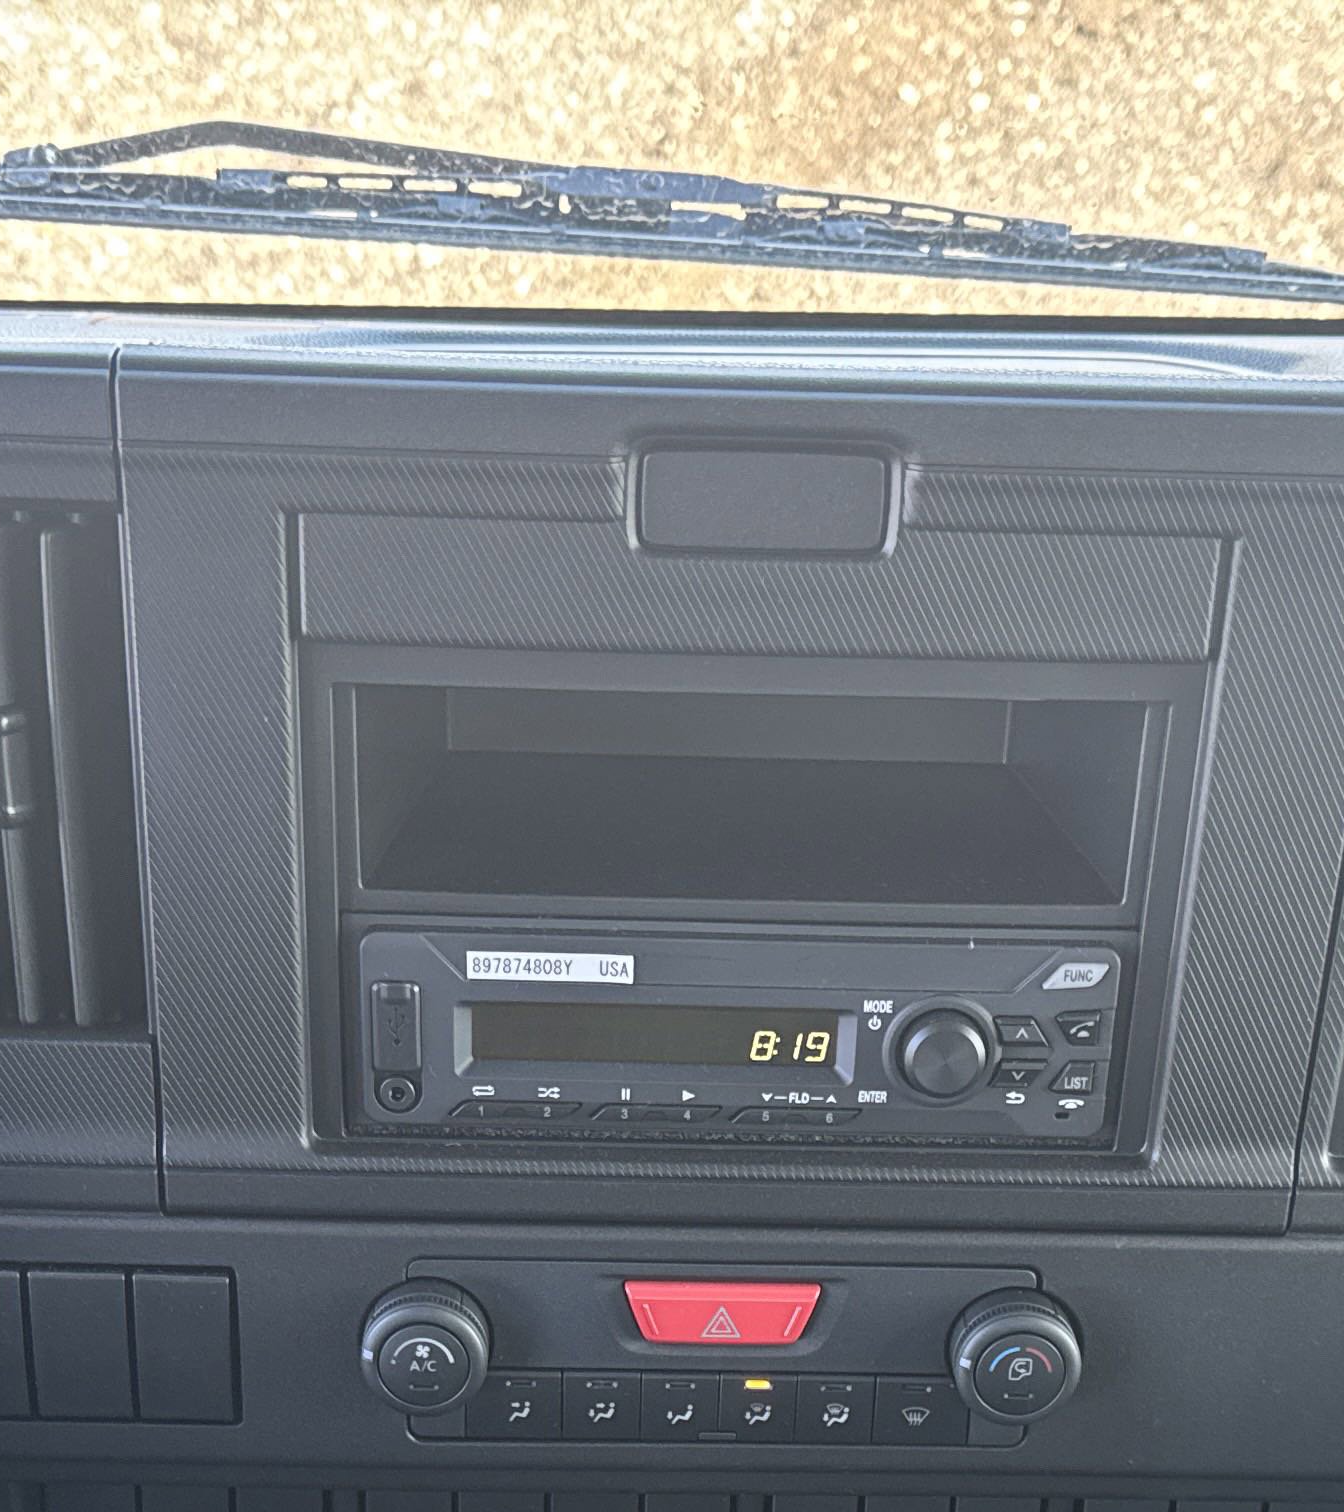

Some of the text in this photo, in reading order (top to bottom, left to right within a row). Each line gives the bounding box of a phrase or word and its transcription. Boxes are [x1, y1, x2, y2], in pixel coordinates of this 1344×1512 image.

[471, 956, 630, 978] 897874808Y USA
[1062, 969, 1095, 983] FUNC
[863, 1000, 894, 1014] MODE
[749, 1030, 830, 1062] 8:19
[1063, 1075, 1089, 1090] LIST
[857, 1090, 888, 1104] ENTER
[477, 1104, 486, 1117] 1
[543, 1106, 552, 1118] 2
[620, 1108, 629, 1120] 3
[682, 1109, 692, 1122] 4
[825, 1112, 834, 1124] 6
[409, 1360, 437, 1372] A/C
